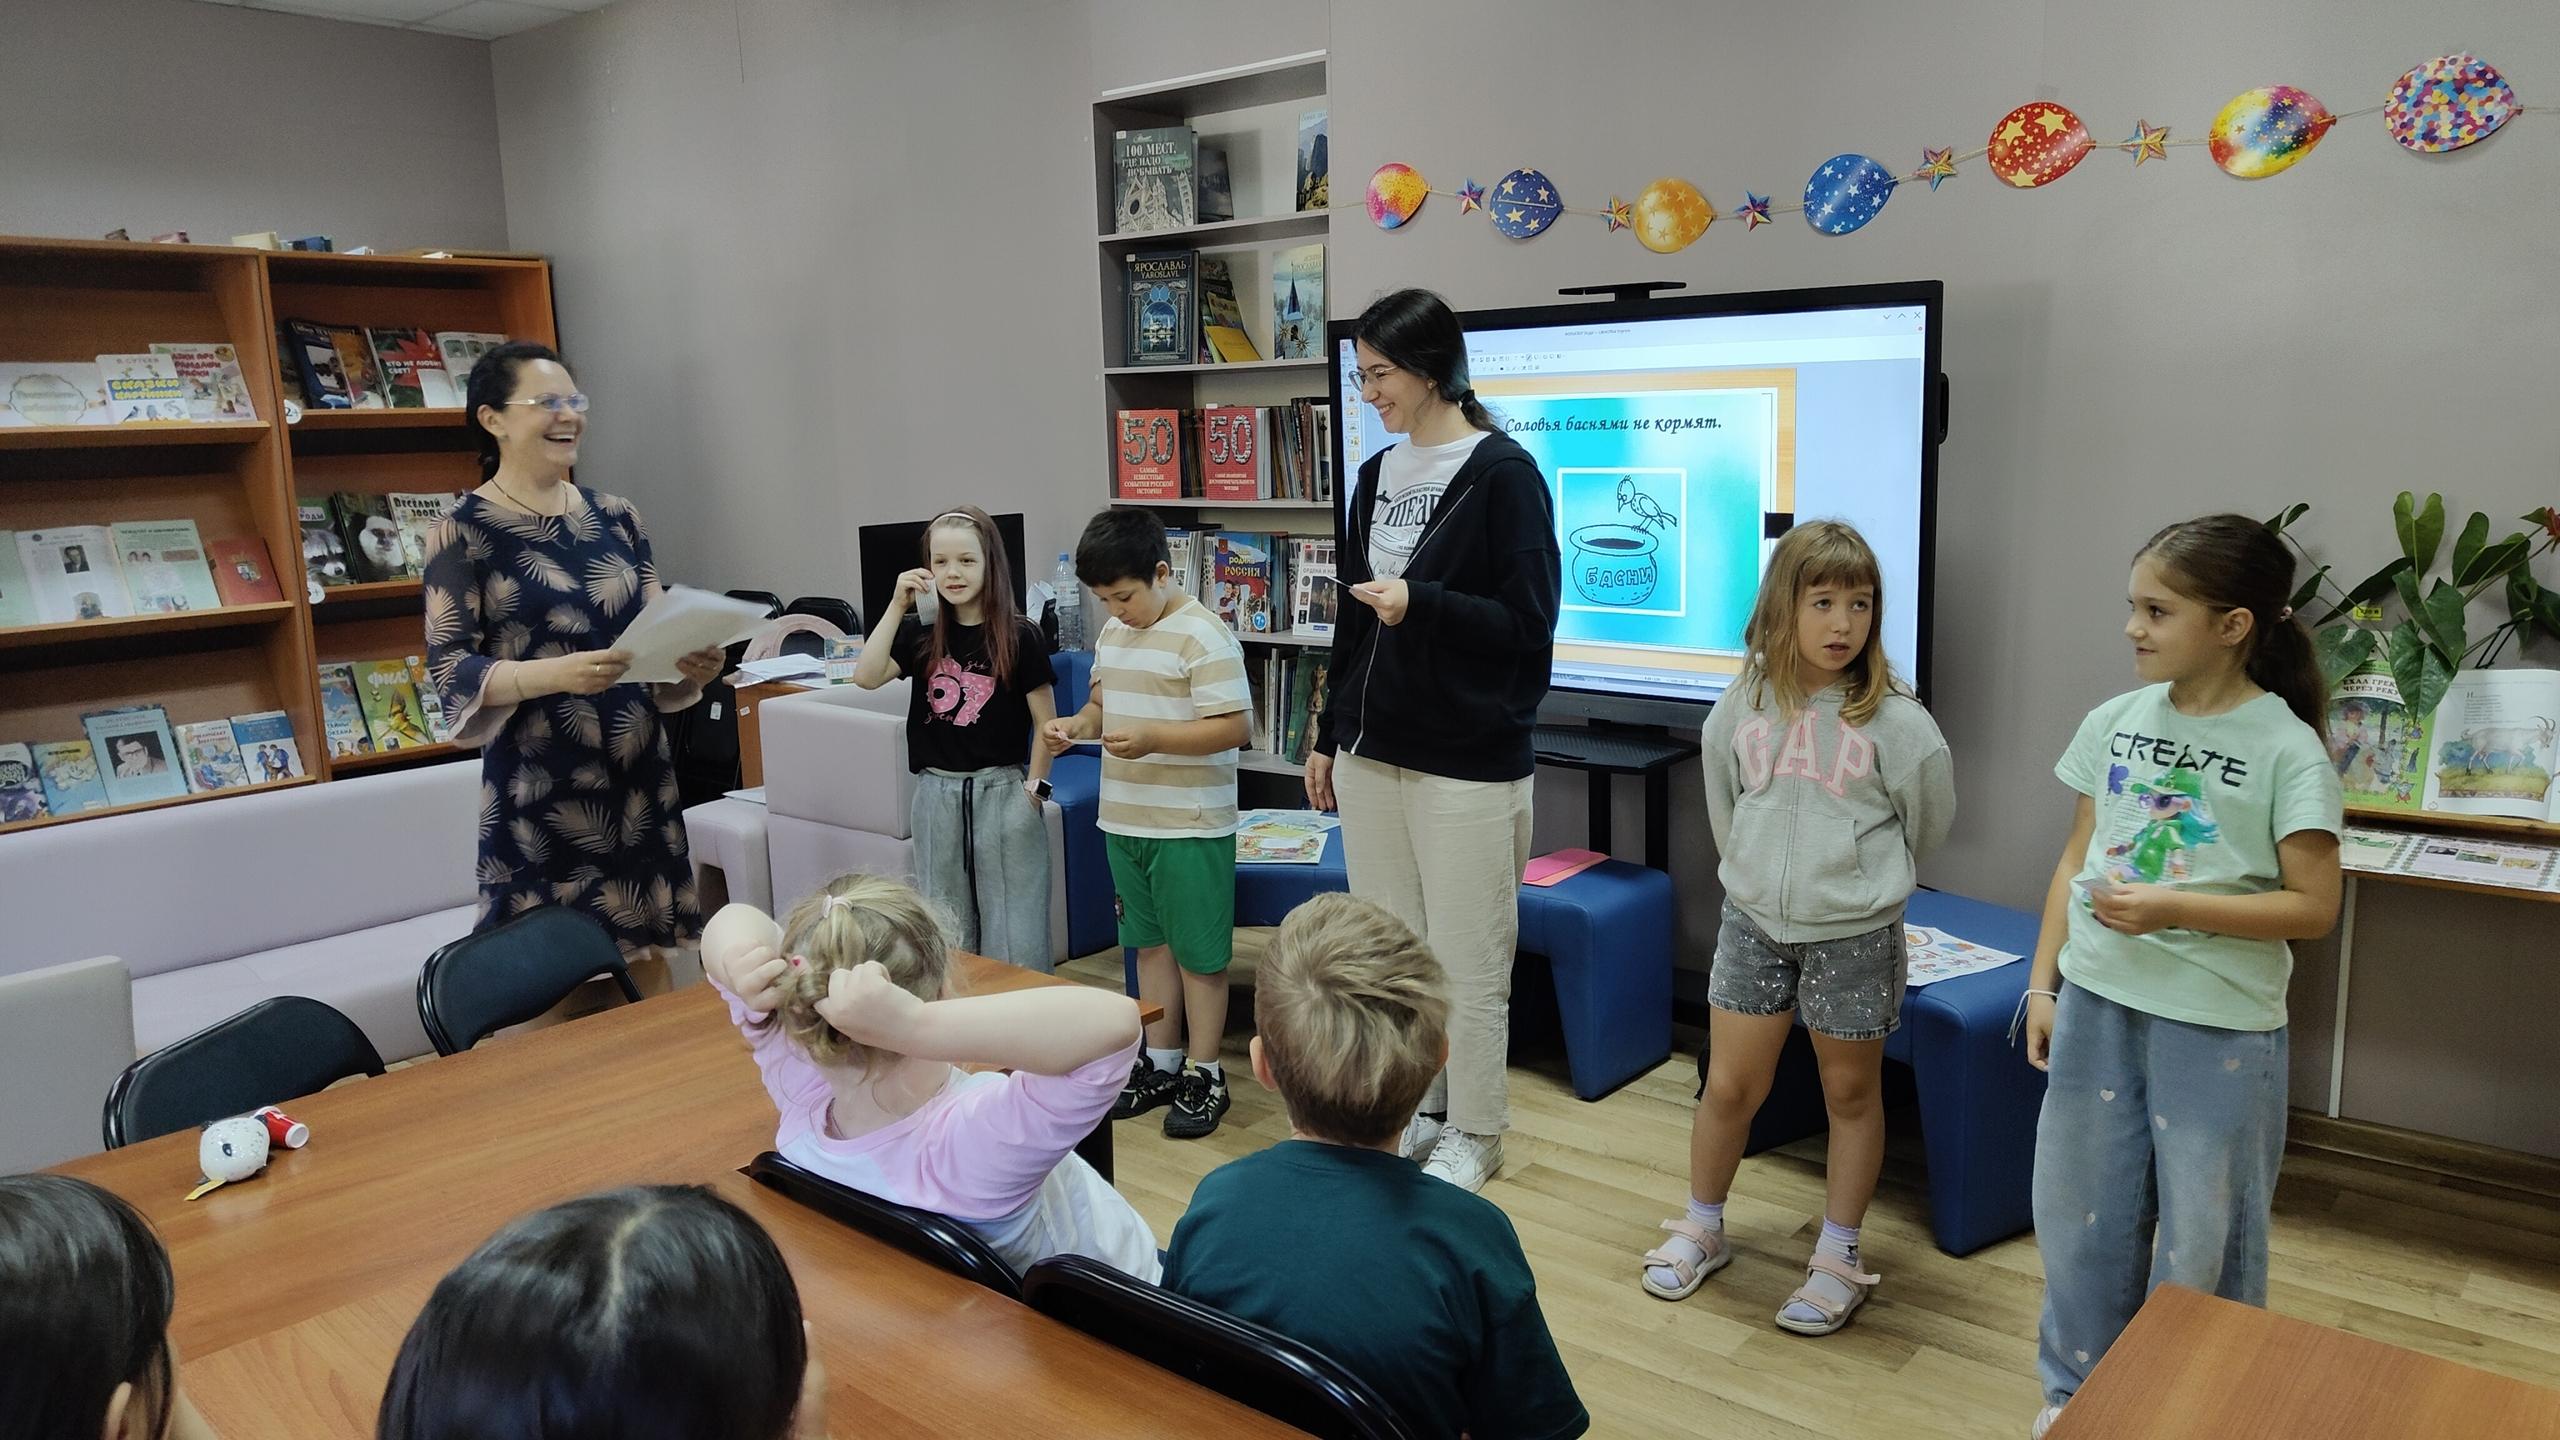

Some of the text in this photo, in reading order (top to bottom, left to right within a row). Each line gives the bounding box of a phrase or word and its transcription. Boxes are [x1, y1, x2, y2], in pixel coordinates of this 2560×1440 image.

[1126, 144, 1143, 157] 100
[1121, 156, 1160, 168] ГДЕ НАДО
[1127, 165, 1172, 177] ПОБЫВАТЬ
[1134, 261, 1187, 273] ЯРОСЛАВЛЬ
[1141, 269, 1180, 279] YAROSLAVL
[112, 379, 179, 390] СКАЗКИ
[1505, 415, 1722, 434] Соловья баснями не кормят.
[1124, 415, 1174, 465] 50
[1209, 415, 1253, 465] 50
[394, 497, 442, 508] ВЕСЁЛЫЙ
[1224, 566, 1260, 577] РОССИЯ
[1586, 566, 1653, 588] БАСНИ
[1255, 616, 1265, 625] 7+
[2343, 685, 2374, 693] ЧЕРЕЗ
[1731, 711, 1875, 797] GAP
[2110, 732, 2247, 787] CREATE
